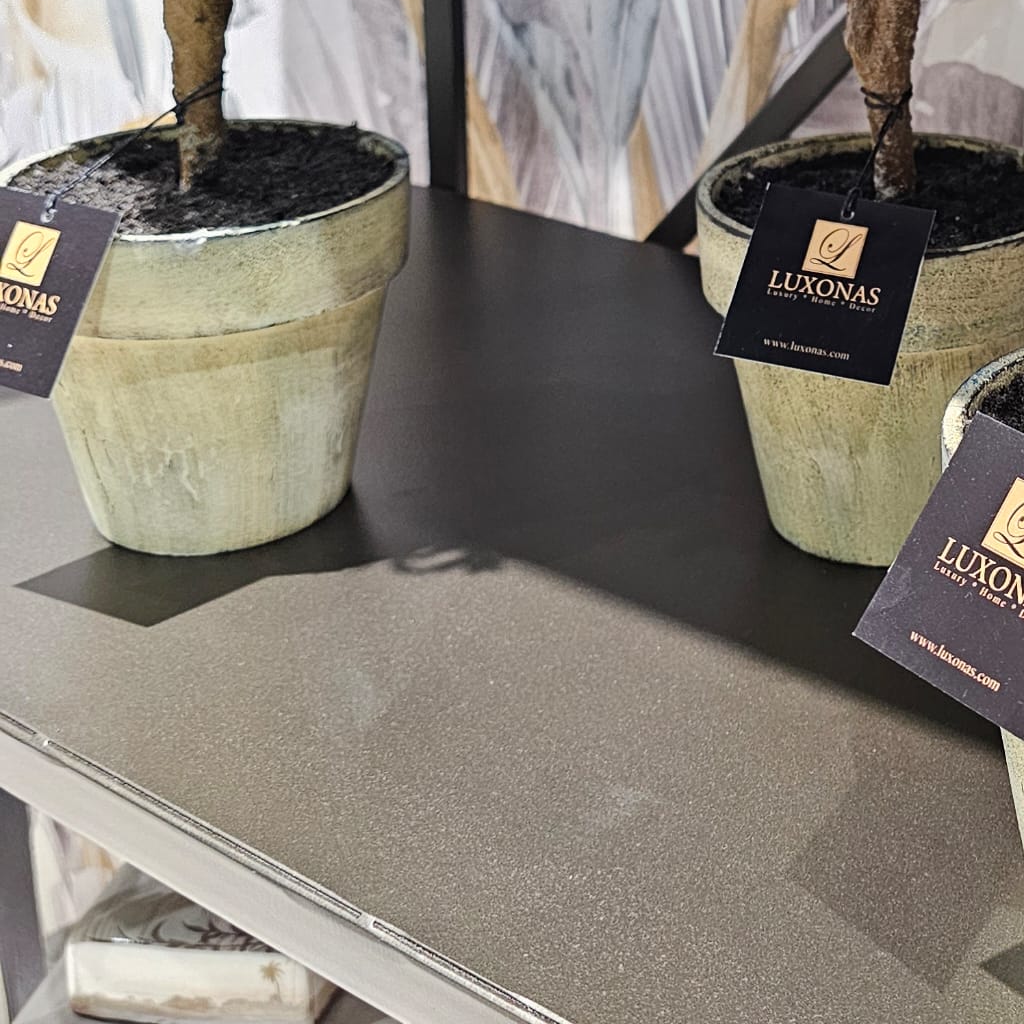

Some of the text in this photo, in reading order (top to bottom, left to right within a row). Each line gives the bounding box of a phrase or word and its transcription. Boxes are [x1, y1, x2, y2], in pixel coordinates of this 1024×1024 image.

[767, 288, 877, 313] Luxury Home Decor
[768, 270, 882, 306] LUXONAS
[763, 337, 850, 361] www.luxonas.com
[933, 561, 969, 588] Luxury
[979, 587, 1007, 609] Home
[910, 630, 1001, 692] www.luxonas.com
